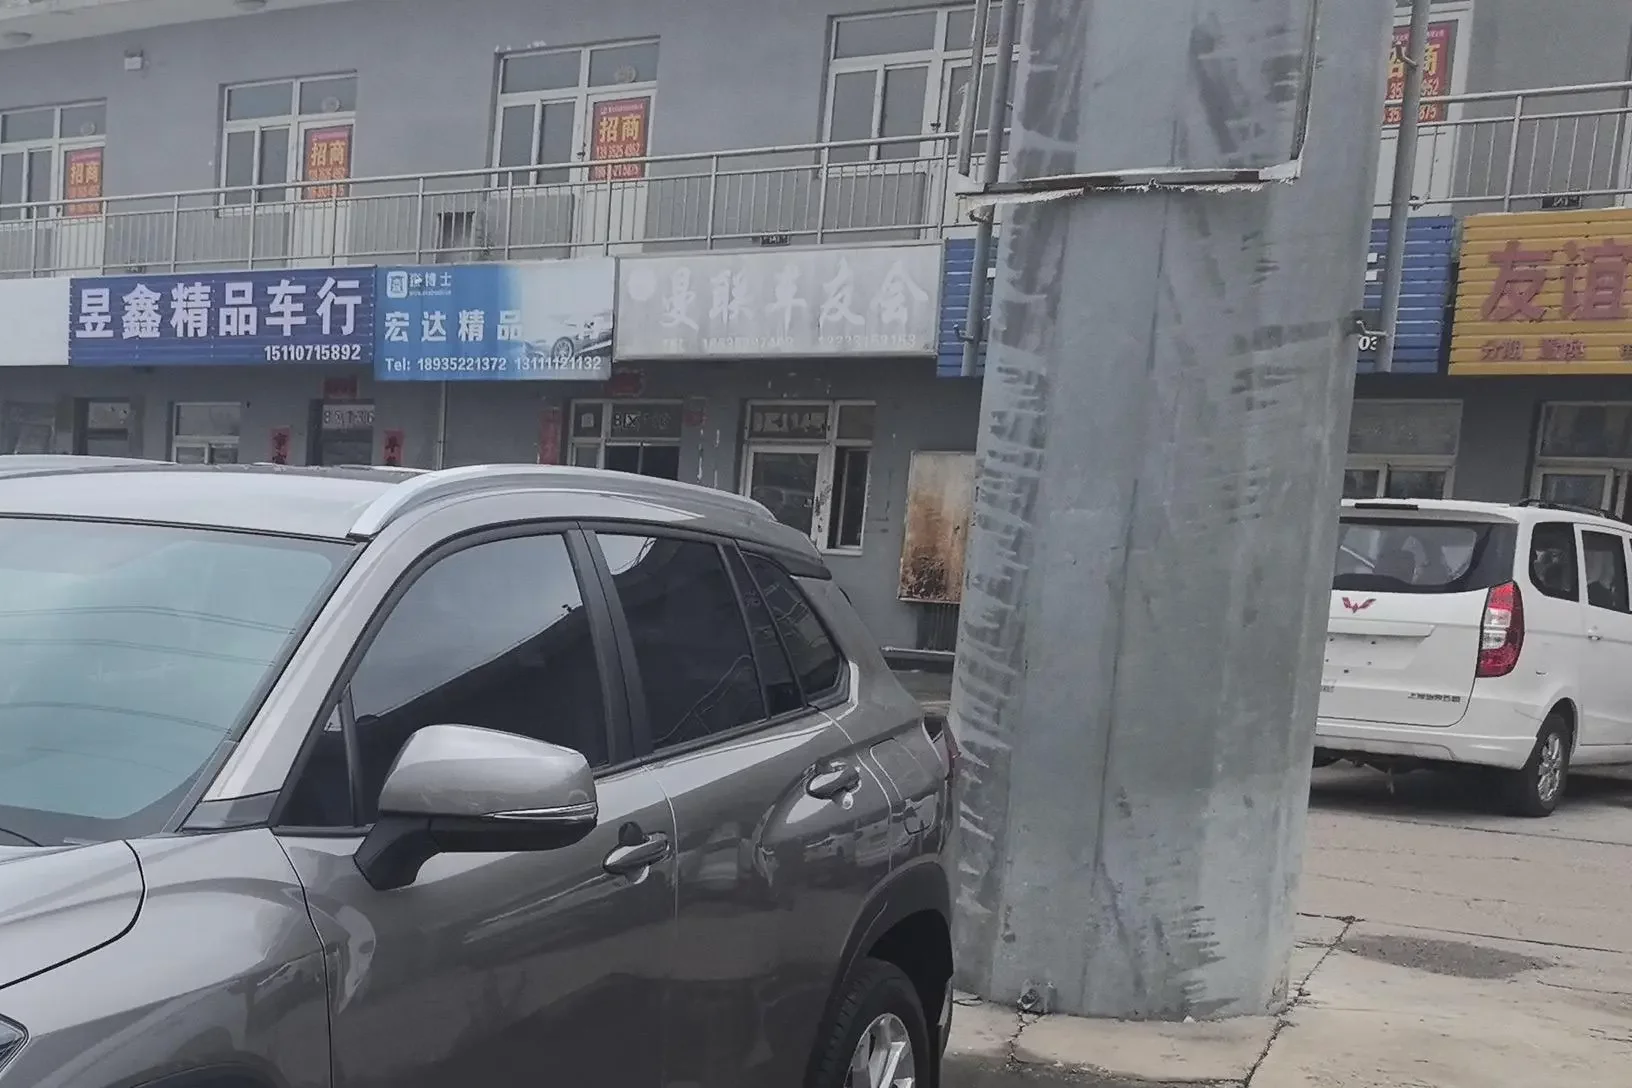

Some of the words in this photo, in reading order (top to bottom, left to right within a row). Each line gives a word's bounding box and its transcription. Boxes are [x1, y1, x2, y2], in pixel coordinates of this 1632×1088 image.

[599, 115, 641, 143] 招商
[75, 276, 362, 339] 昱鑫精品车行
[384, 310, 520, 343] 宏达精品
[265, 345, 361, 361] 15110715892
[385, 358, 411, 372] Tel:
[417, 357, 507, 371] 18935221372
